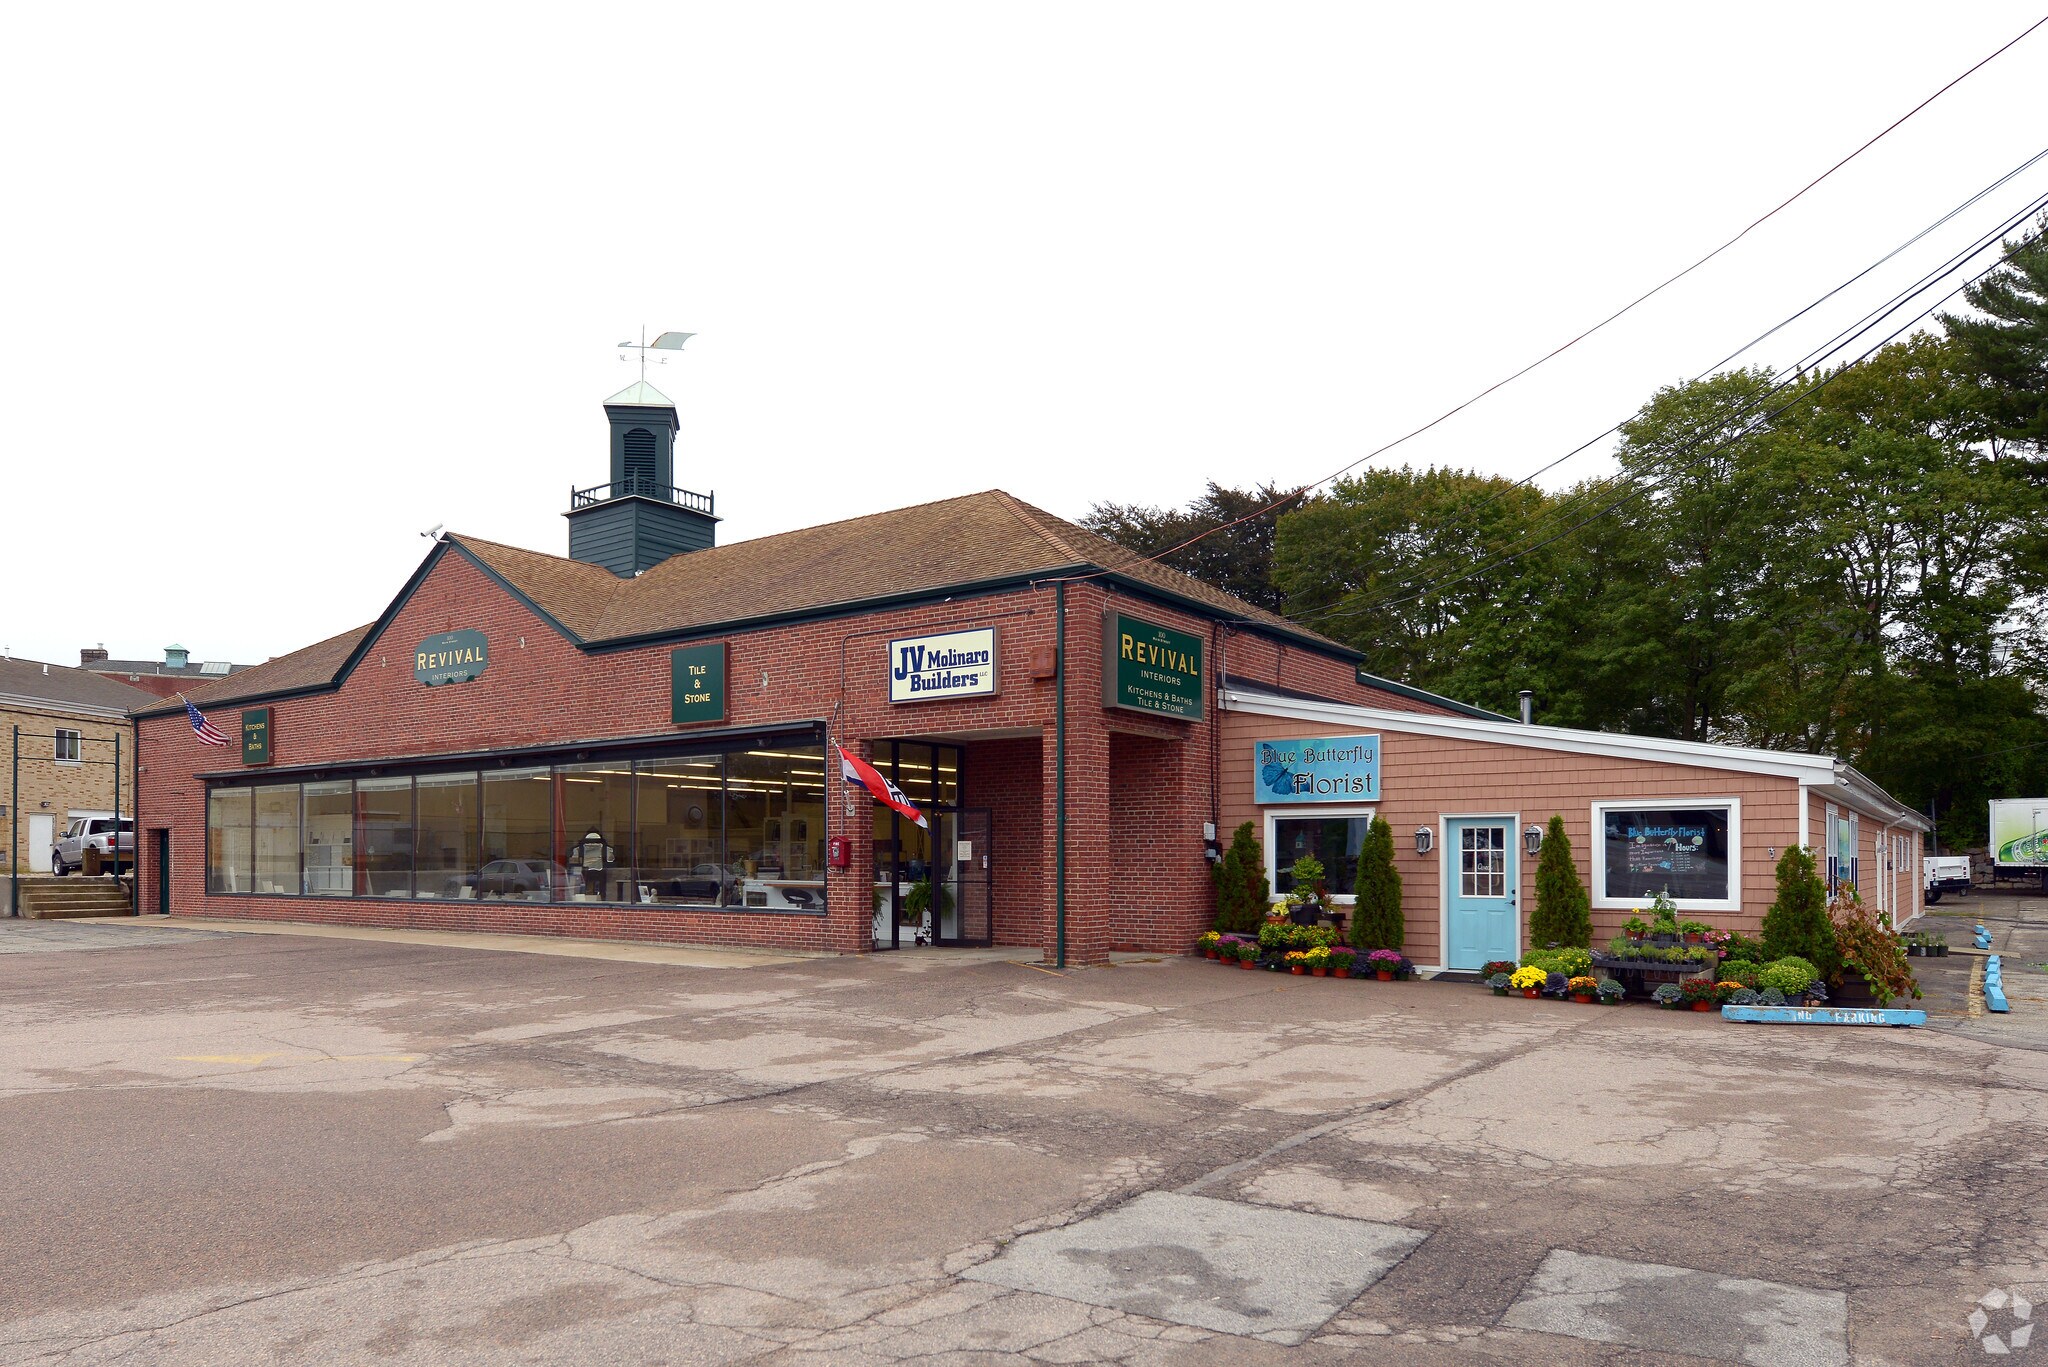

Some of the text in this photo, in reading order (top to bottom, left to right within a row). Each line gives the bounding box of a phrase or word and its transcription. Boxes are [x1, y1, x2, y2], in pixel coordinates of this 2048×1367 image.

[417, 647, 483, 671] REVIVAL
[894, 645, 989, 680] JV Molinaro
[1122, 634, 1198, 675] REVIVAL
[432, 669, 468, 681] INTERIORS
[688, 665, 706, 676] TILE
[1141, 670, 1181, 686] INTERIORS
[694, 678, 701, 689] &
[910, 671, 979, 692] Builders
[684, 693, 711, 704] STONE
[1127, 684, 1163, 700] KITCHENS
[1171, 694, 1193, 706] BATHS
[1137, 696, 1184, 713] TILE & STONE
[1261, 745, 1373, 765] Blue Butterfly
[1293, 771, 1372, 795] Florist
[1628, 827, 1706, 838] Blue Butterfly Florist
[1675, 843, 1699, 852] Hours:
[1797, 1010, 1886, 1023] NO PARKING
